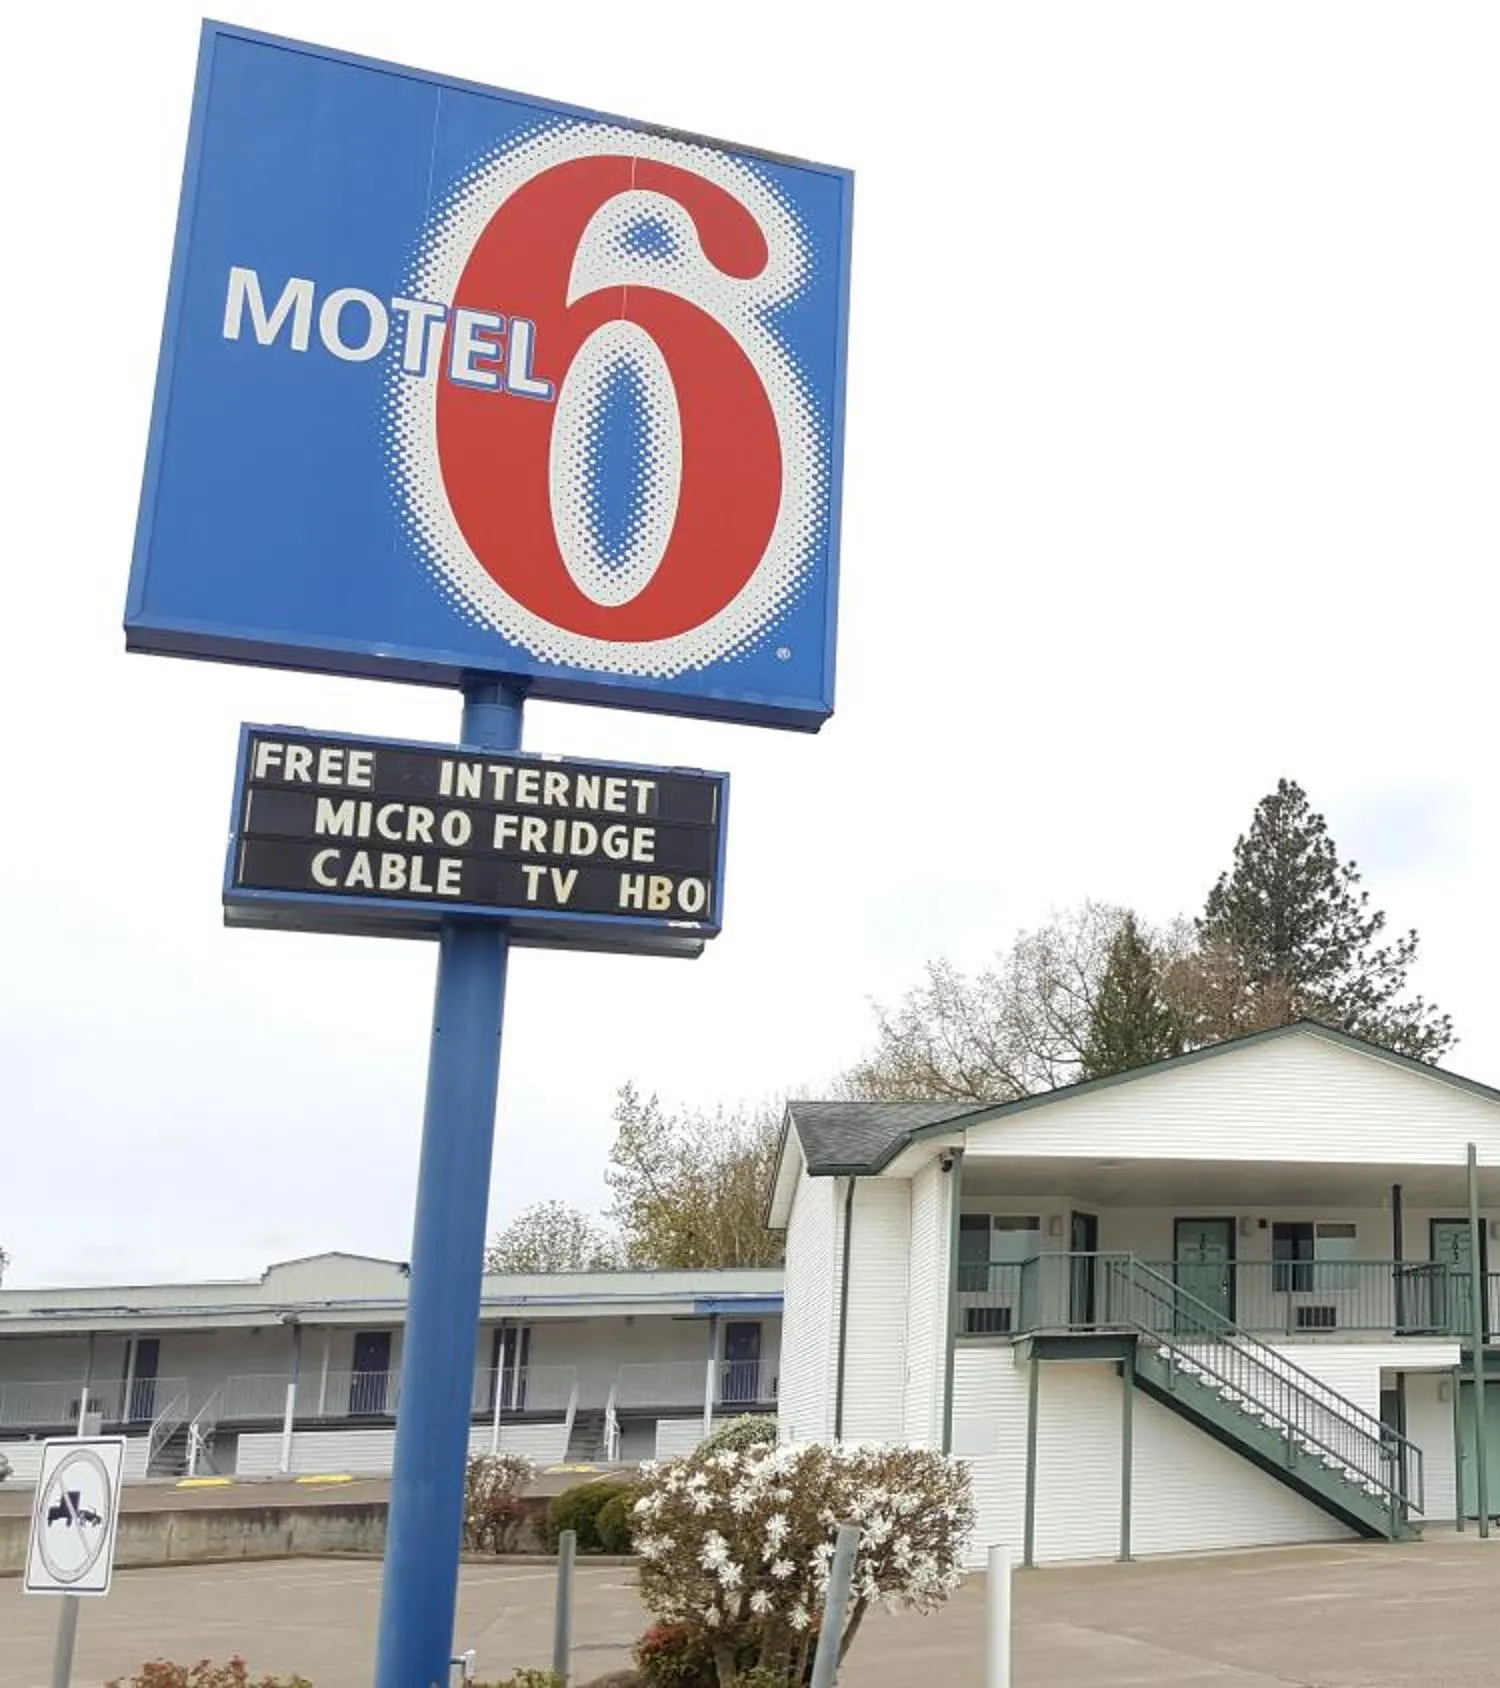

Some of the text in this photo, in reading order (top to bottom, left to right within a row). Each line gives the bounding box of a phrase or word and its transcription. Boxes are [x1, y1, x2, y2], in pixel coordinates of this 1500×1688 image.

[222, 153, 783, 643] MOTEL 6
[253, 741, 657, 815] FREE INTERNET
[313, 798, 657, 863] MICRO FRIDGE
[310, 849, 706, 913] CABLE TV HBO
